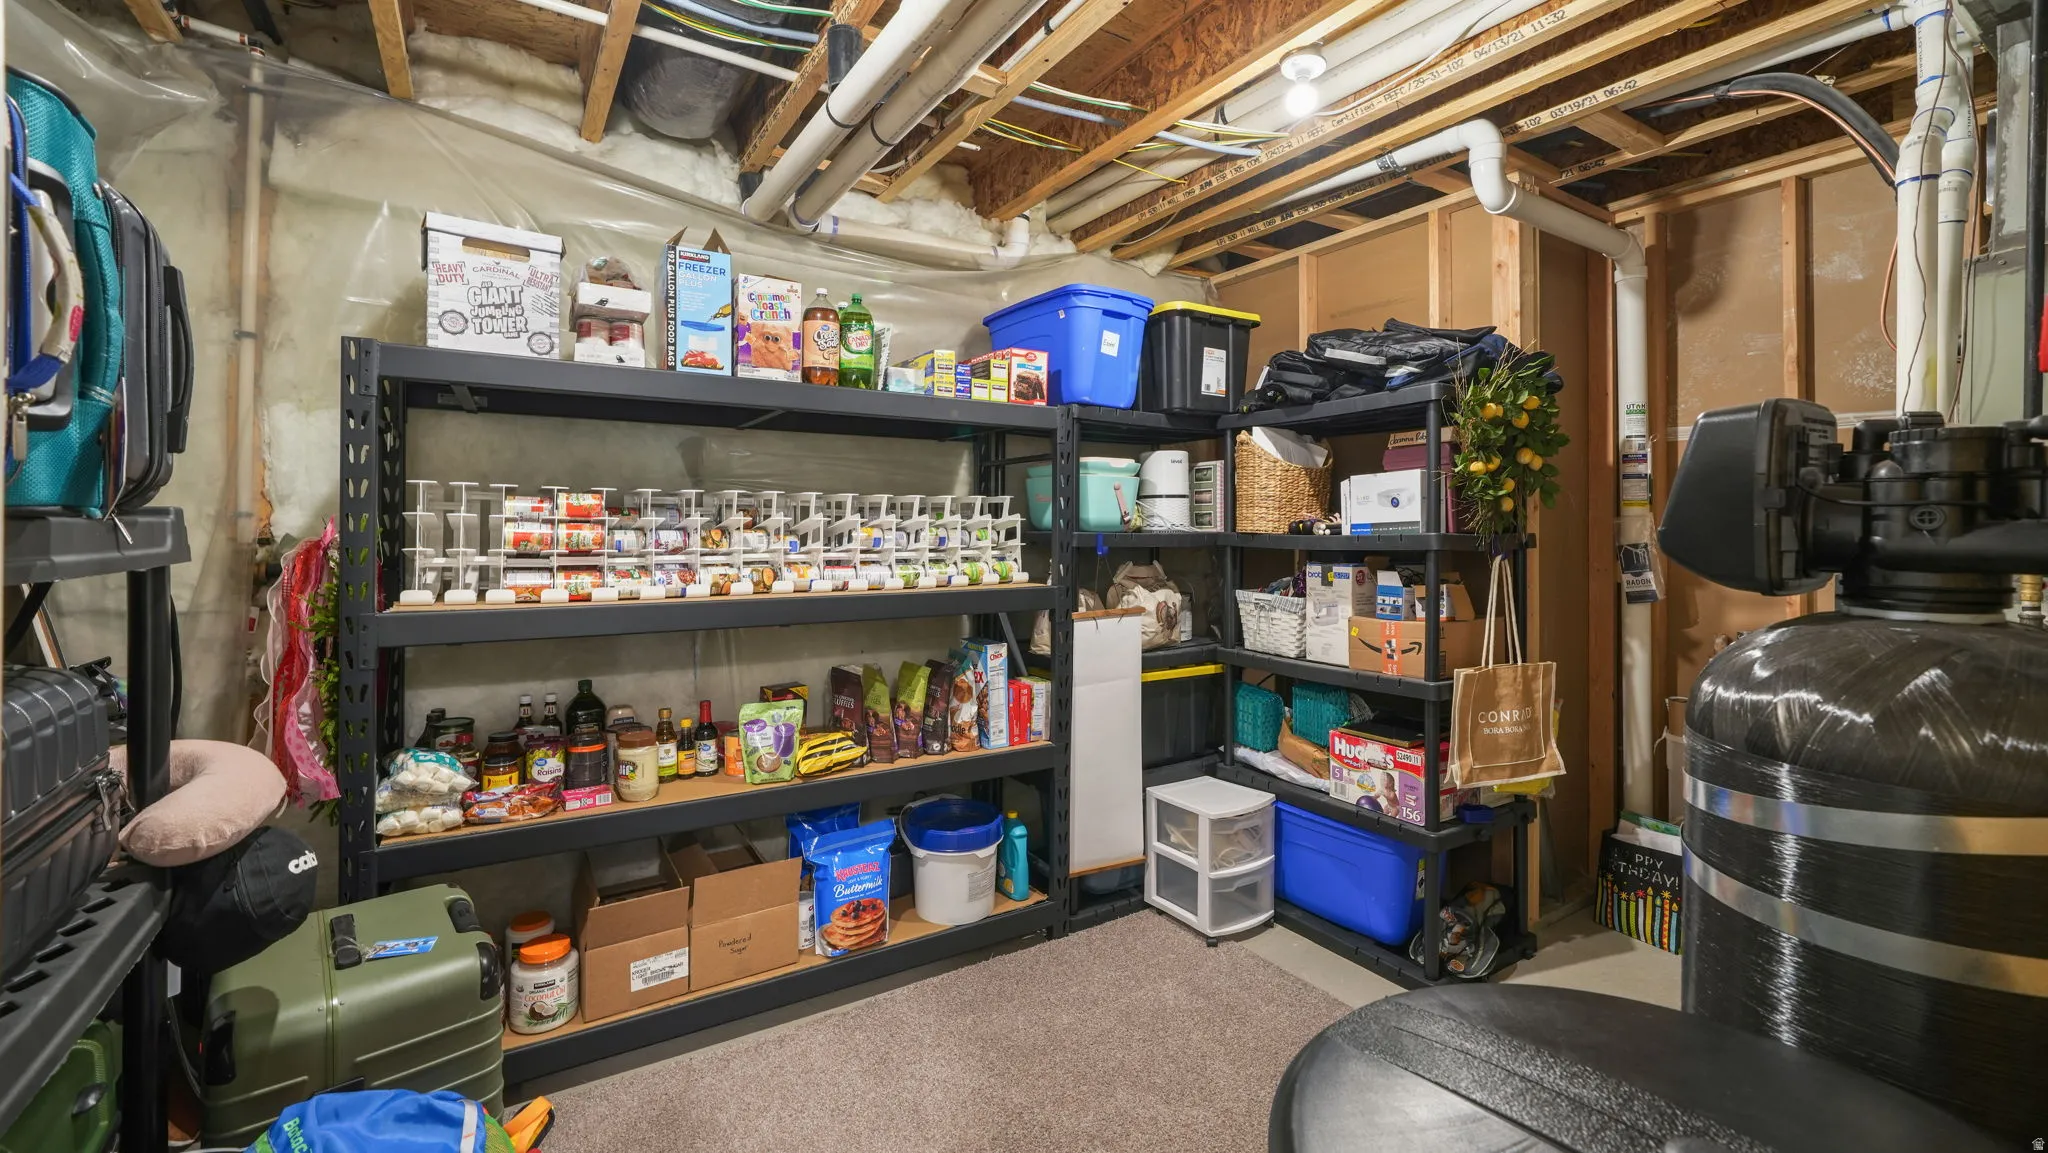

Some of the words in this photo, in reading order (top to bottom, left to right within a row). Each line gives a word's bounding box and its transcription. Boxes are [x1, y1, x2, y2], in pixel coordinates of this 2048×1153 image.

[1331, 102, 1376, 128] Certified
[1473, 30, 1525, 59] 04/13/21
[1530, 9, 1568, 34] 11:32
[1550, 91, 1600, 120] 03/19/21
[1603, 79, 1639, 99] 06:42
[666, 250, 675, 262] 192
[434, 263, 464, 273] HEAVY
[472, 266, 521, 280] CARDINAL
[678, 261, 726, 276] FREEZER
[437, 273, 465, 284] DUTY
[529, 267, 555, 285] ULTRA
[666, 264, 676, 296] GALLON
[678, 270, 718, 282] GALLON
[678, 279, 704, 288] PLUS
[467, 285, 523, 306] GIANT
[748, 292, 791, 303] Cinnamon
[470, 302, 525, 319] JUMBLING
[666, 298, 676, 318] PLUS
[755, 301, 785, 311] Toast
[751, 308, 792, 321] Crunch
[471, 315, 529, 335] TOWER
[666, 320, 675, 343] FOOD
[855, 341, 869, 349] DRY
[666, 344, 675, 367] BAGS
[1625, 578, 1652, 586] RADON
[973, 671, 984, 684] ex
[1477, 706, 1533, 724] CONRAD
[1483, 726, 1504, 735] BORA
[1504, 725, 1523, 734] BORA
[537, 767, 562, 776] Raisins
[1401, 806, 1421, 822] 156
[835, 861, 881, 882] KRUSTEAZ
[1617, 861, 1680, 891] THDAY!
[833, 875, 883, 898] Buttermilk
[718, 933, 752, 948] Powdered
[730, 945, 748, 955] Sugar
[525, 990, 554, 1002] Coconut
[555, 988, 566, 998] Oil
